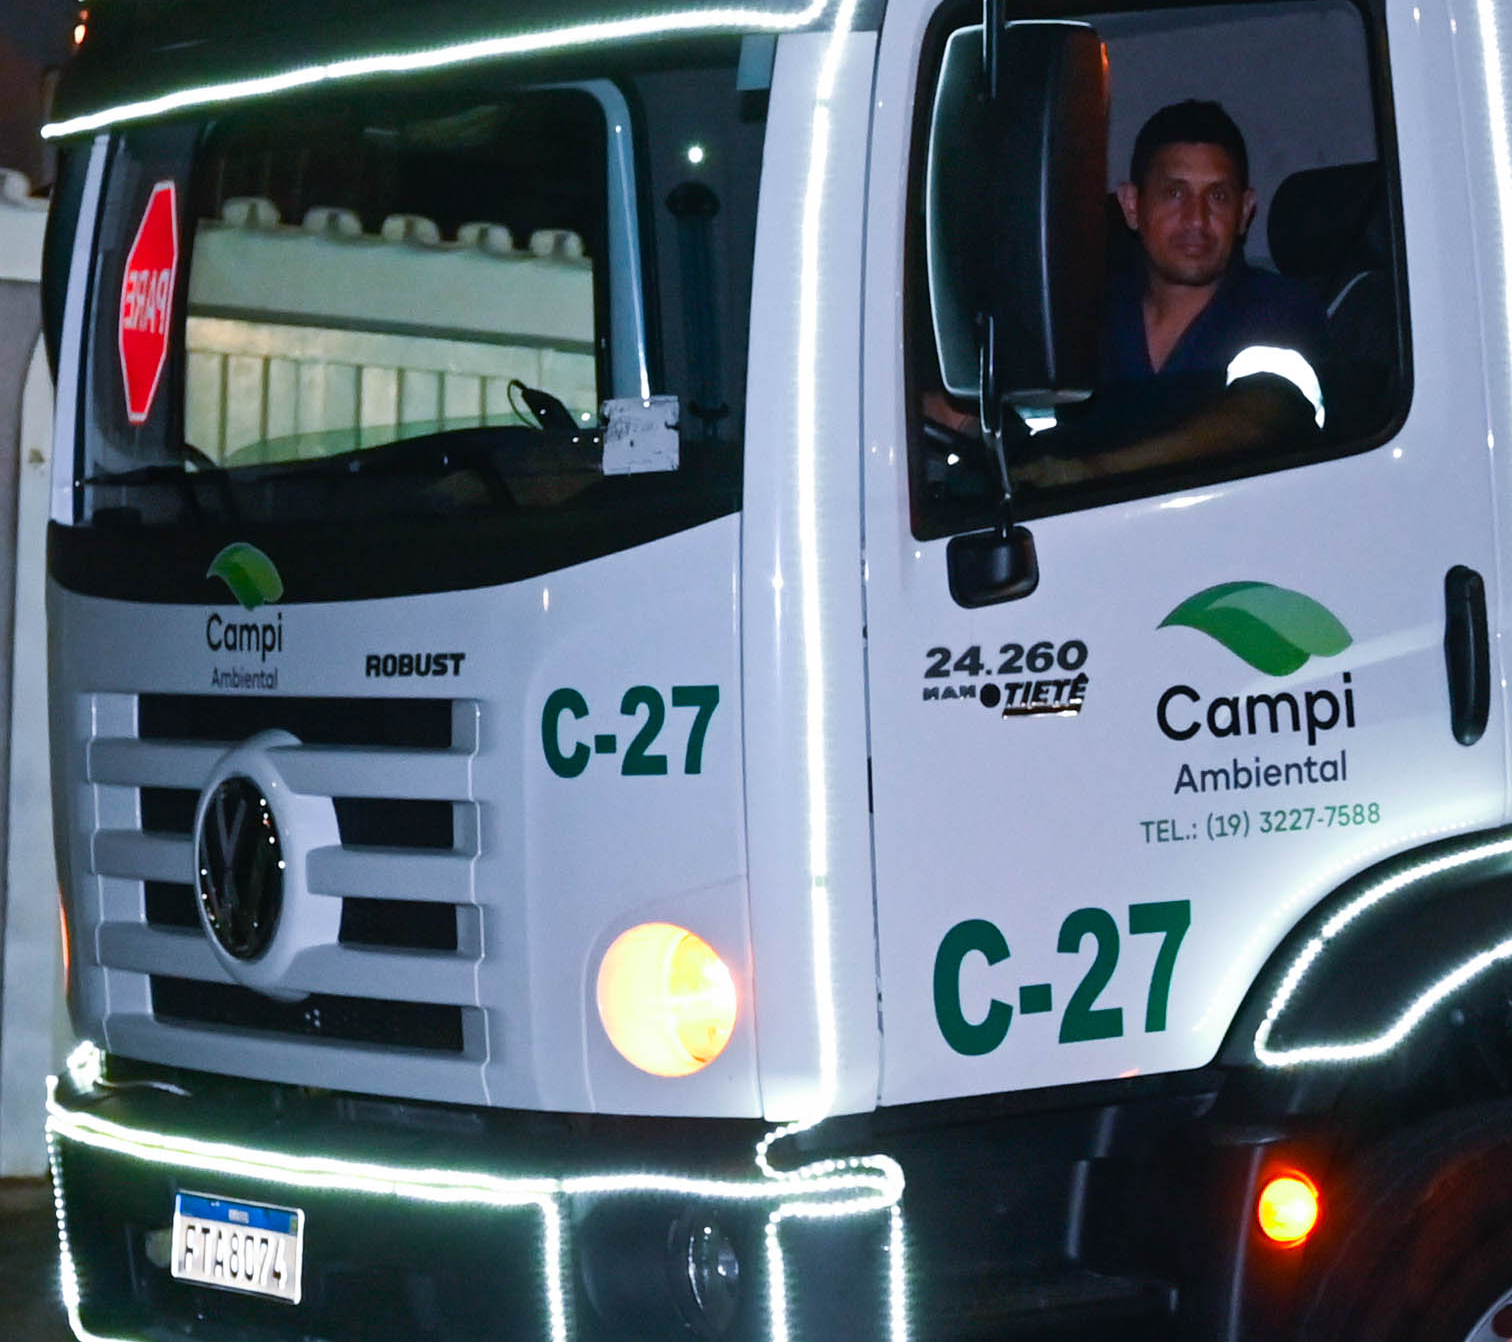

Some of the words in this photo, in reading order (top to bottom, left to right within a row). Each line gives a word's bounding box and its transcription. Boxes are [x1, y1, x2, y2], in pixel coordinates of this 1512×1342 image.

[206, 612, 283, 662] Campi
[924, 640, 1088, 678] 24.260
[211, 666, 278, 690] Ambiental
[365, 652, 466, 677] ROBUST
[1156, 672, 1356, 746] Campi
[540, 685, 721, 779] C-27
[1174, 749, 1347, 794] Ambiental
[1140, 819, 1198, 843] TEL.:
[1207, 810, 1250, 841] (19)
[1259, 802, 1381, 834] 3227-7588
[933, 899, 1191, 1056] C-27
